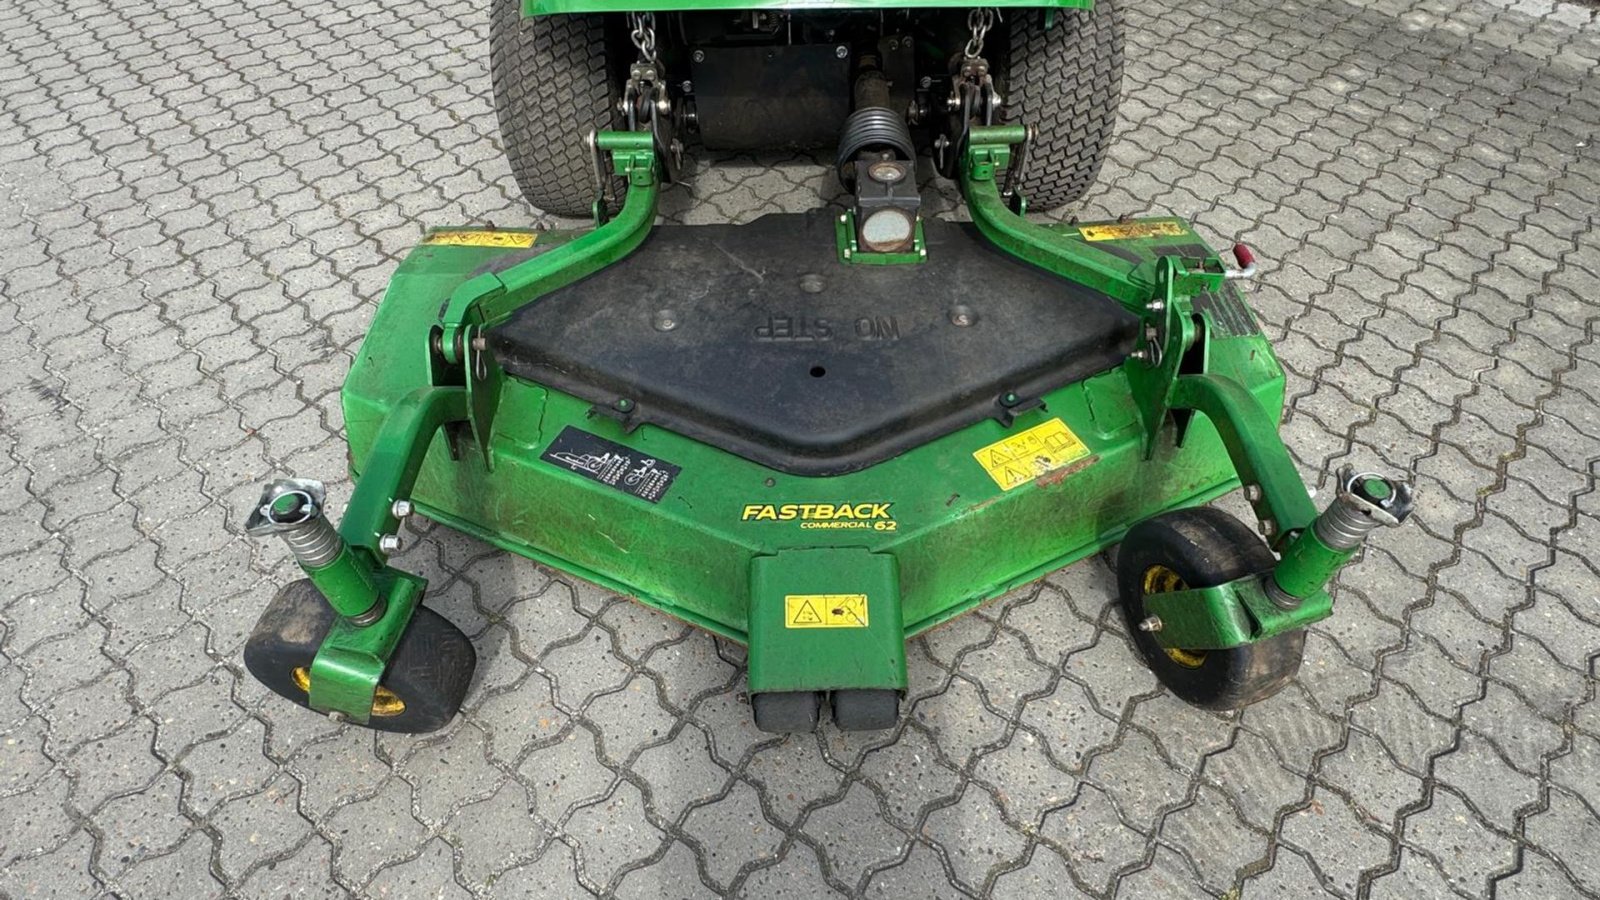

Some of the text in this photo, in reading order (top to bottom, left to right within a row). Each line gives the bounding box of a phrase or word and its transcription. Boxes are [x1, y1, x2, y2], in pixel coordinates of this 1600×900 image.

[754, 316, 899, 341] NO STEP
[741, 503, 893, 521] FASTBACK
[800, 521, 897, 531] COMMERCIAL 62
